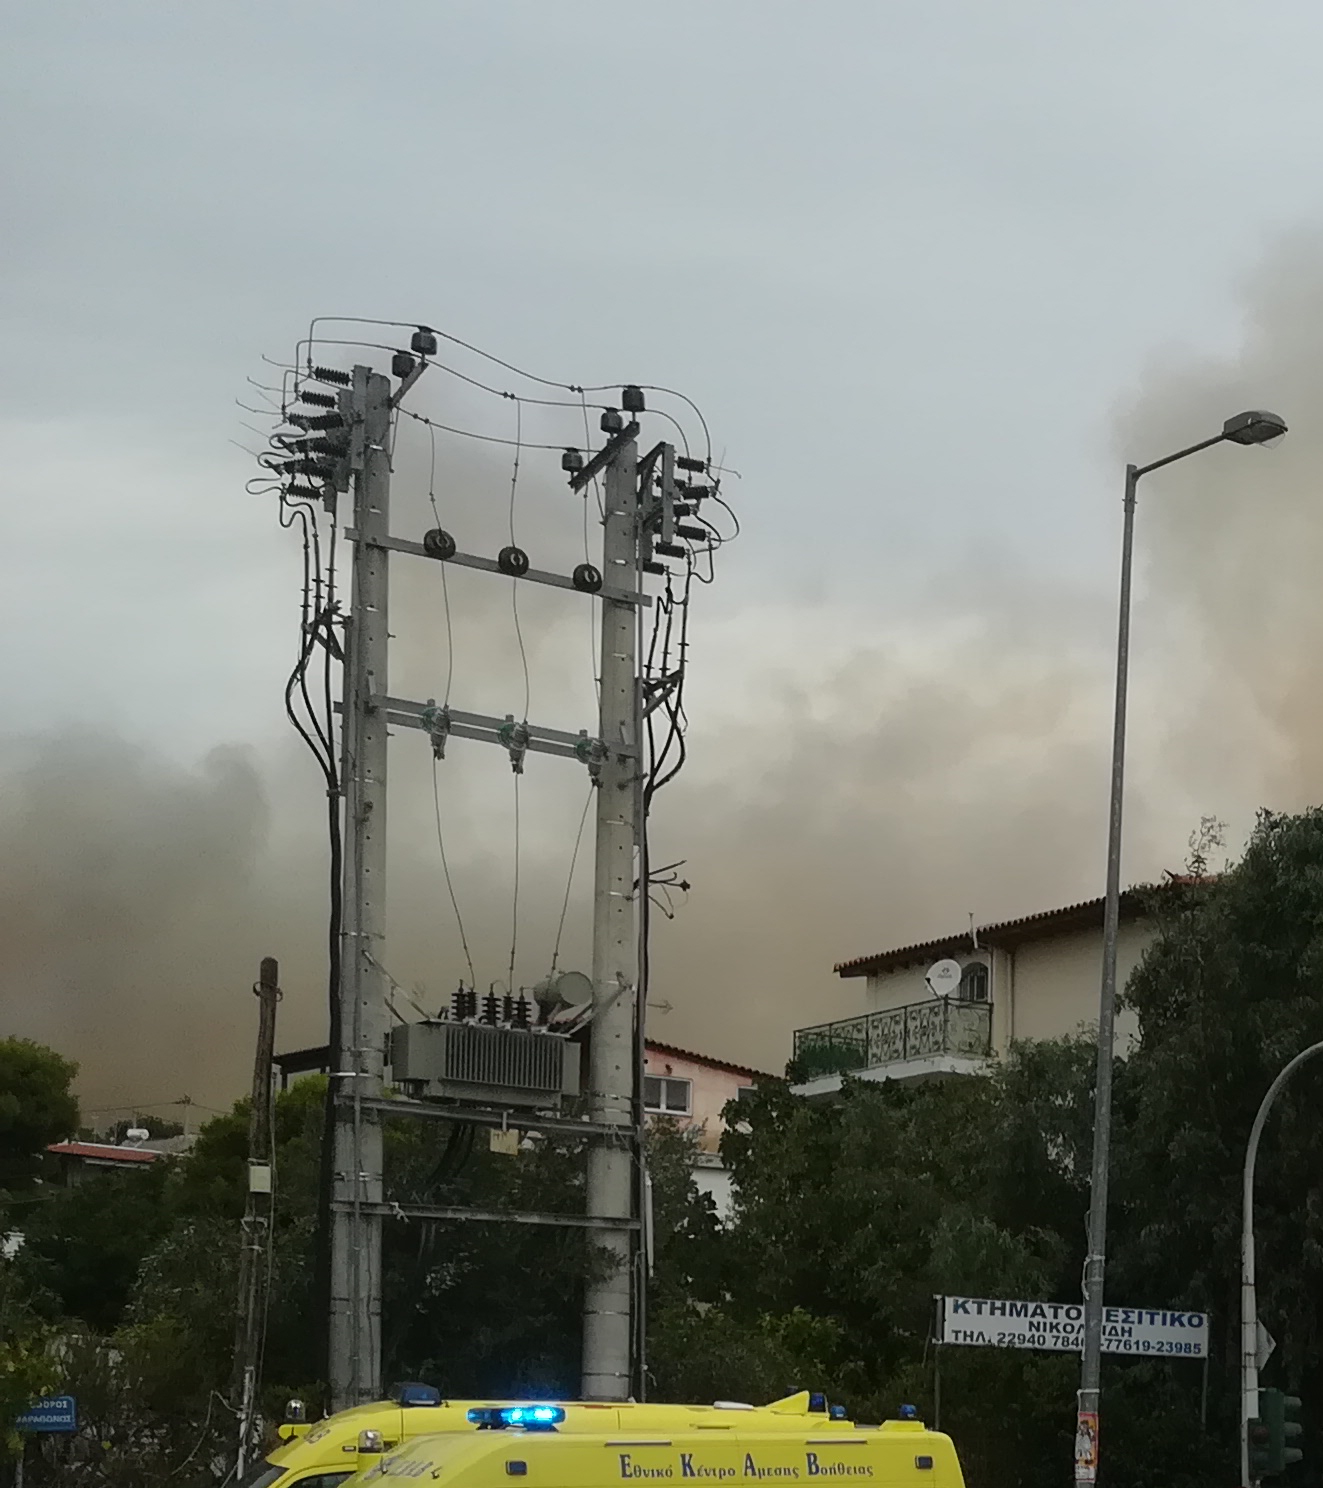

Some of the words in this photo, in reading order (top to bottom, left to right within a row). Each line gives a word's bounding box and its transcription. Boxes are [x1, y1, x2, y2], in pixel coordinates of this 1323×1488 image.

[952, 1299, 1204, 1328] ΚΤΗΜΑΤΟΕΣΙΤΙΚΟ
[952, 1330, 992, 1344] ΤΗΛ.
[997, 1333, 1046, 1348] 22940
[680, 1452, 736, 1480] Κέντρο
[805, 1452, 874, 1478] Βοήθειας
